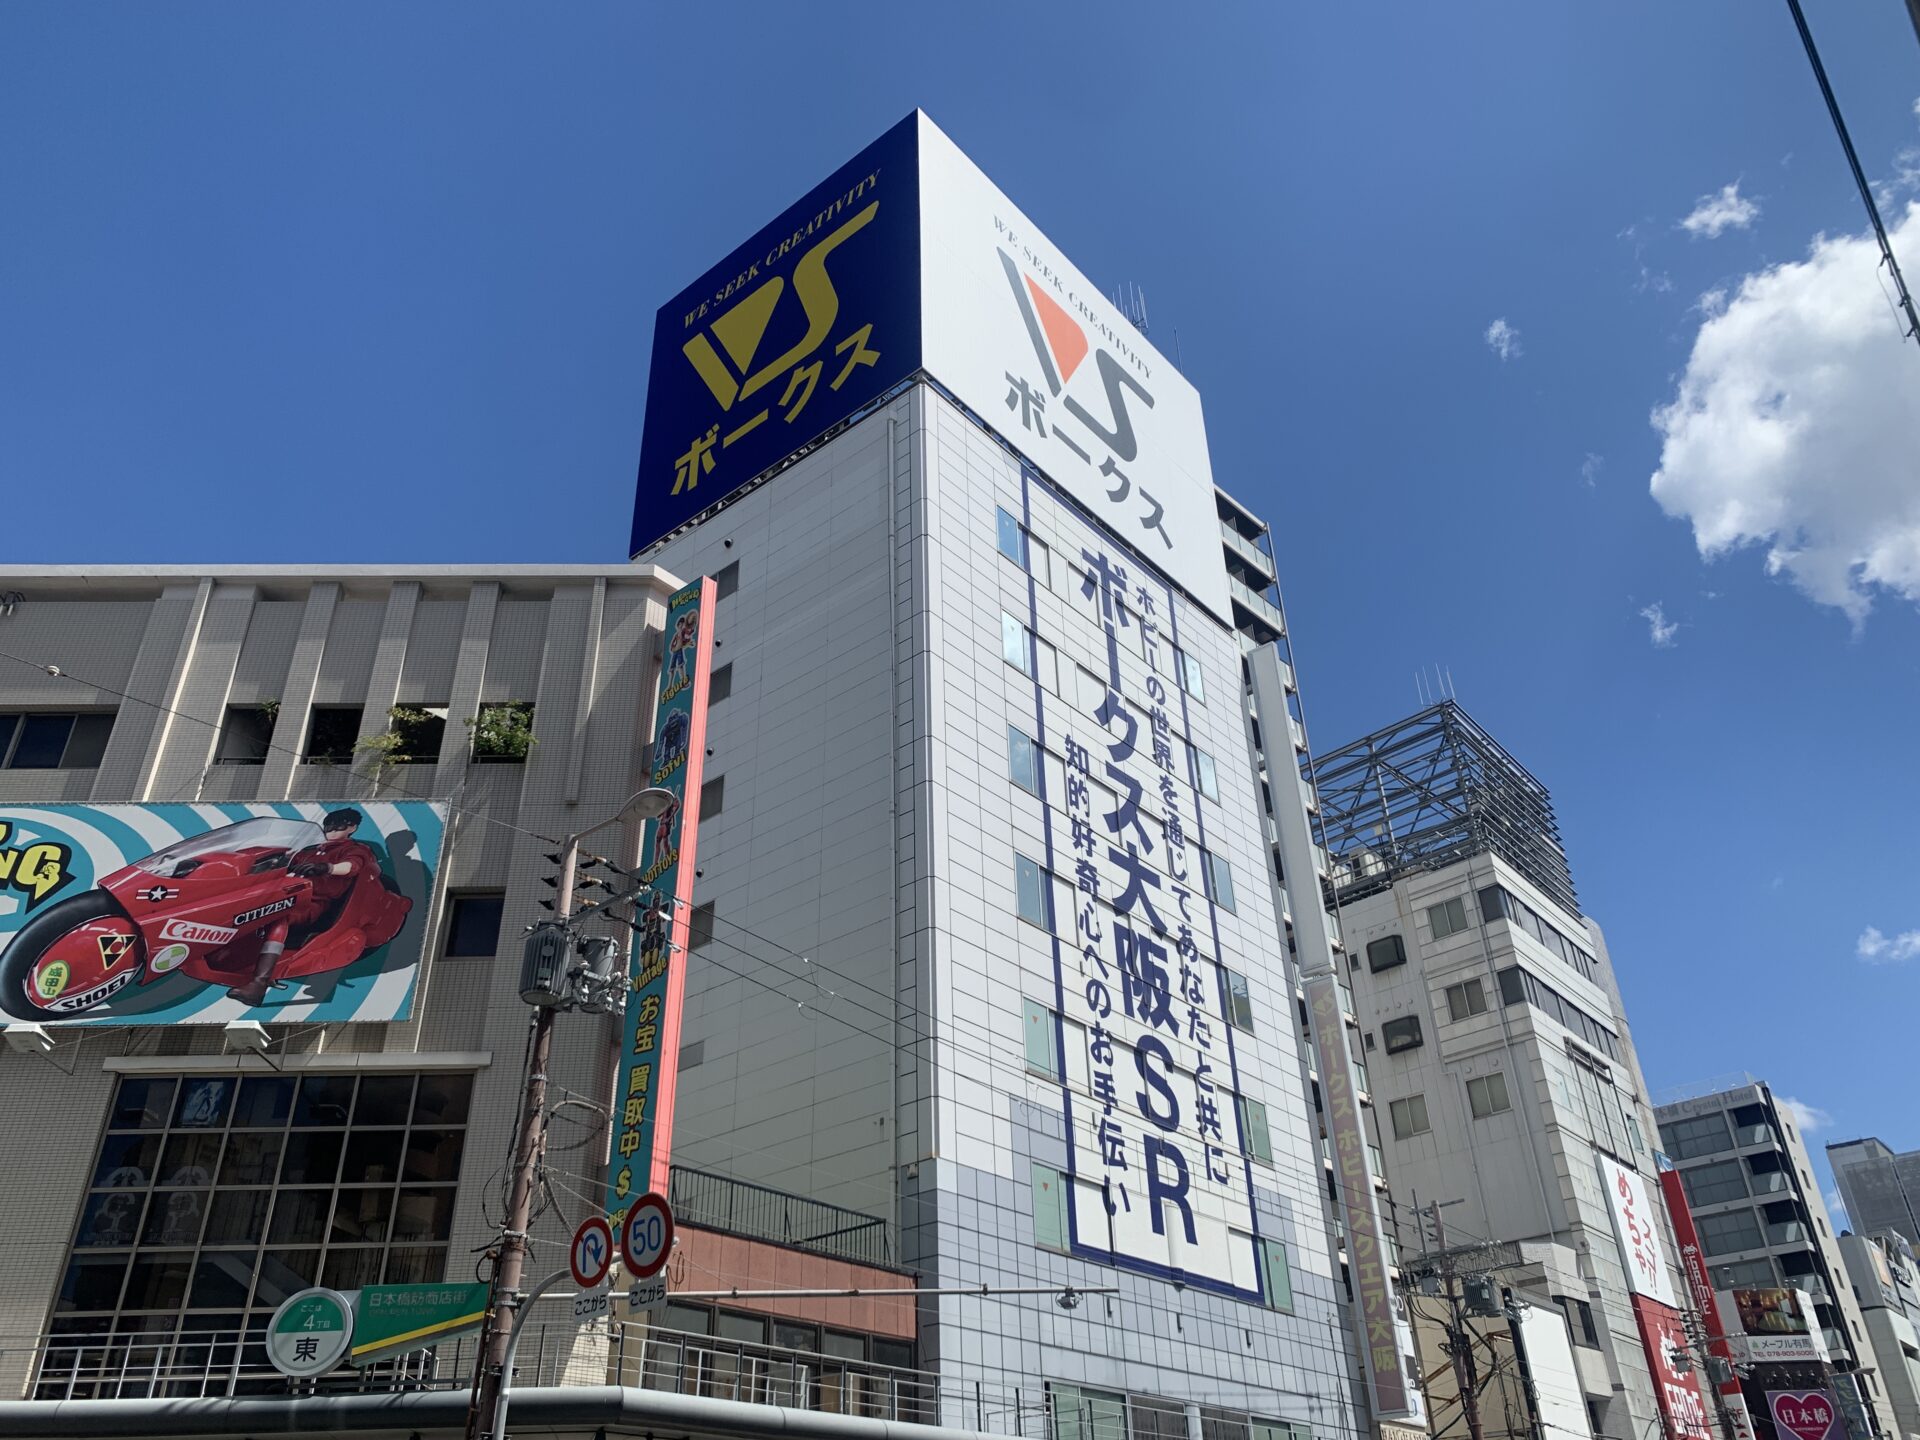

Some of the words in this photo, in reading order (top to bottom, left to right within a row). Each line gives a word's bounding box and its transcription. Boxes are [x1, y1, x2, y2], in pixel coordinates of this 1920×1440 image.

[683, 300, 708, 328] WE
[713, 260, 761, 308] SEEK
[765, 168, 882, 267] CREATIVITY
[992, 214, 1018, 248] WE
[1021, 242, 1066, 295] SEEK
[1068, 290, 1154, 380] CREATIVITY
[670, 322, 881, 496] ボークス
[1004, 369, 1174, 551] ボークス
[660, 675, 690, 706] Figure
[654, 750, 687, 786] Sofvi
[1080, 546, 1199, 1246] ボークス大阪SR
[1135, 585, 1229, 1185] ホビーの世界を通じてあなたと共に
[166, 921, 233, 943] Canon
[234, 897, 295, 926] CITIZEN
[42, 967, 64, 997] 成田山
[61, 974, 126, 1011] SHOEI
[632, 956, 668, 993] Vintage
[1063, 733, 1131, 1217] 知的好奇心へのお手伝い
[633, 995, 661, 1055] お宝
[619, 1065, 651, 1157] 買取中
[1320, 1023, 1353, 1119] ボークス
[1337, 1126, 1397, 1373] ホビースクエア大阪
[632, 1215, 661, 1256] 50
[1616, 1168, 1647, 1275] めちゃ
[574, 1294, 608, 1316] ここから
[629, 1284, 665, 1307] ここから
[1688, 1255, 1712, 1315] GAME
[304, 1314, 331, 1330] 4丁目
[292, 1336, 320, 1362] 東
[1782, 1407, 1829, 1425] 日本橋
